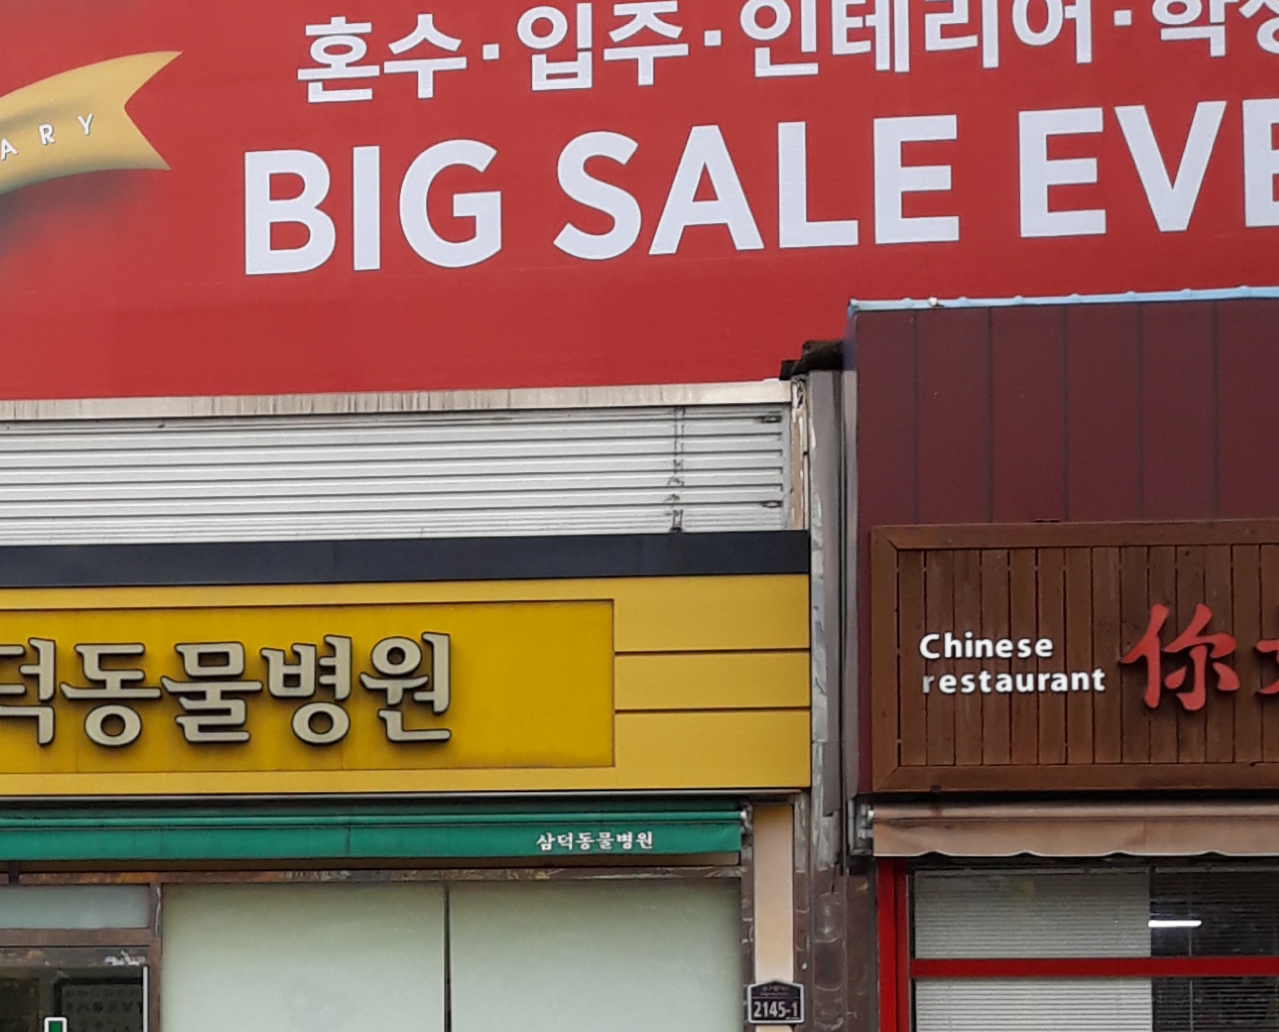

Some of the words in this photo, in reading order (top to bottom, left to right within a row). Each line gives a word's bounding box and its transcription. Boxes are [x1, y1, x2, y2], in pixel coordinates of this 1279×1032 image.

[243, 138, 503, 276] BIG
[552, 115, 960, 260] SALE
[918, 631, 1055, 660] Chinese
[1120, 602, 1279, 711] 你
[921, 668, 1107, 694] restaurant
[535, 830, 655, 852] 삼덕동물병원
[753, 1000, 799, 1019] 2145-1
